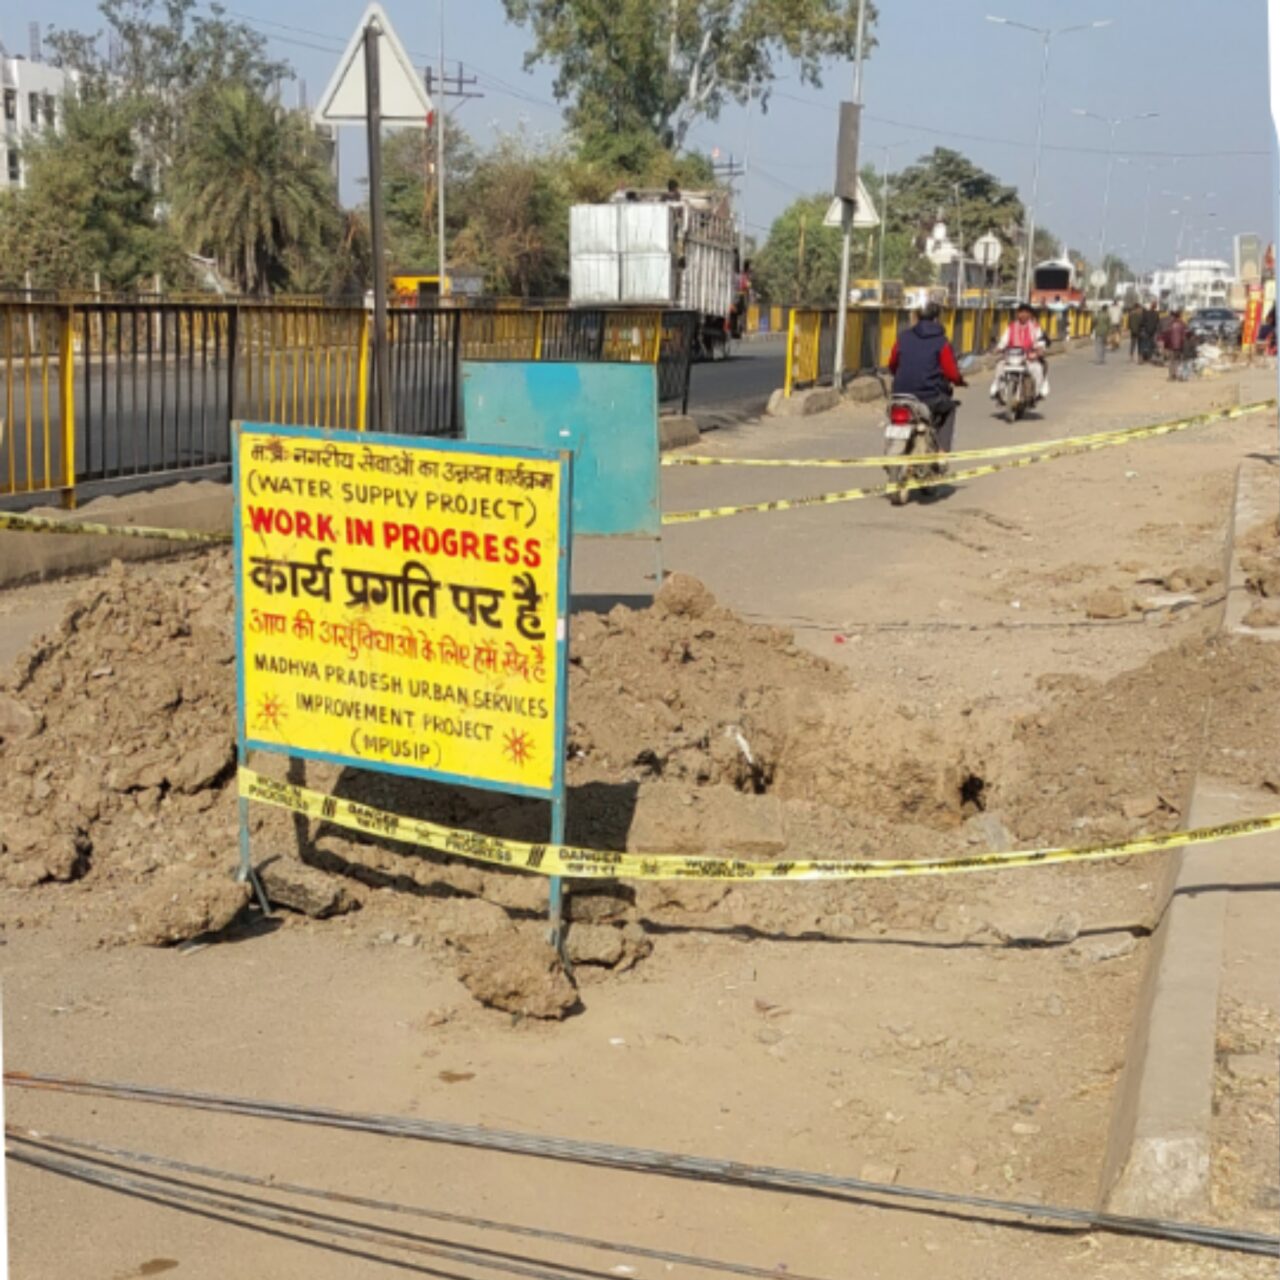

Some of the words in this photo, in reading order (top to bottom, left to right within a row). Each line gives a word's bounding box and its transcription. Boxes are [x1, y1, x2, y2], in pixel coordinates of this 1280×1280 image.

[293, 444, 354, 469] नगरीय
[357, 446, 413, 476] सेवाओं
[418, 460, 439, 478] का
[495, 463, 554, 491] कार्यक्रम
[247, 469, 333, 499] (WATER
[341, 482, 419, 509] SUPPLY
[426, 491, 537, 528] PROJECT)
[248, 505, 337, 543] WORK
[346, 517, 374, 547] IN
[382, 521, 541, 568] PROGRESS
[249, 547, 333, 602] कार्य
[341, 560, 441, 618] प्रगति
[447, 582, 505, 629] पर
[512, 570, 546, 640] है
[249, 608, 287, 635] आप
[292, 608, 315, 640] की
[418, 630, 435, 662] के
[437, 634, 470, 669] लिए
[531, 643, 547, 683] है
[254, 653, 320, 681] MADHYA
[324, 664, 403, 695] PRADESH
[408, 678, 467, 705] URBAN
[473, 688, 548, 719] SERVICES
[296, 692, 415, 728] IMPROVEMENT
[422, 713, 493, 741] PROJECT
[351, 727, 442, 768] (MPUSIP)
[559, 849, 622, 864] DANGER
